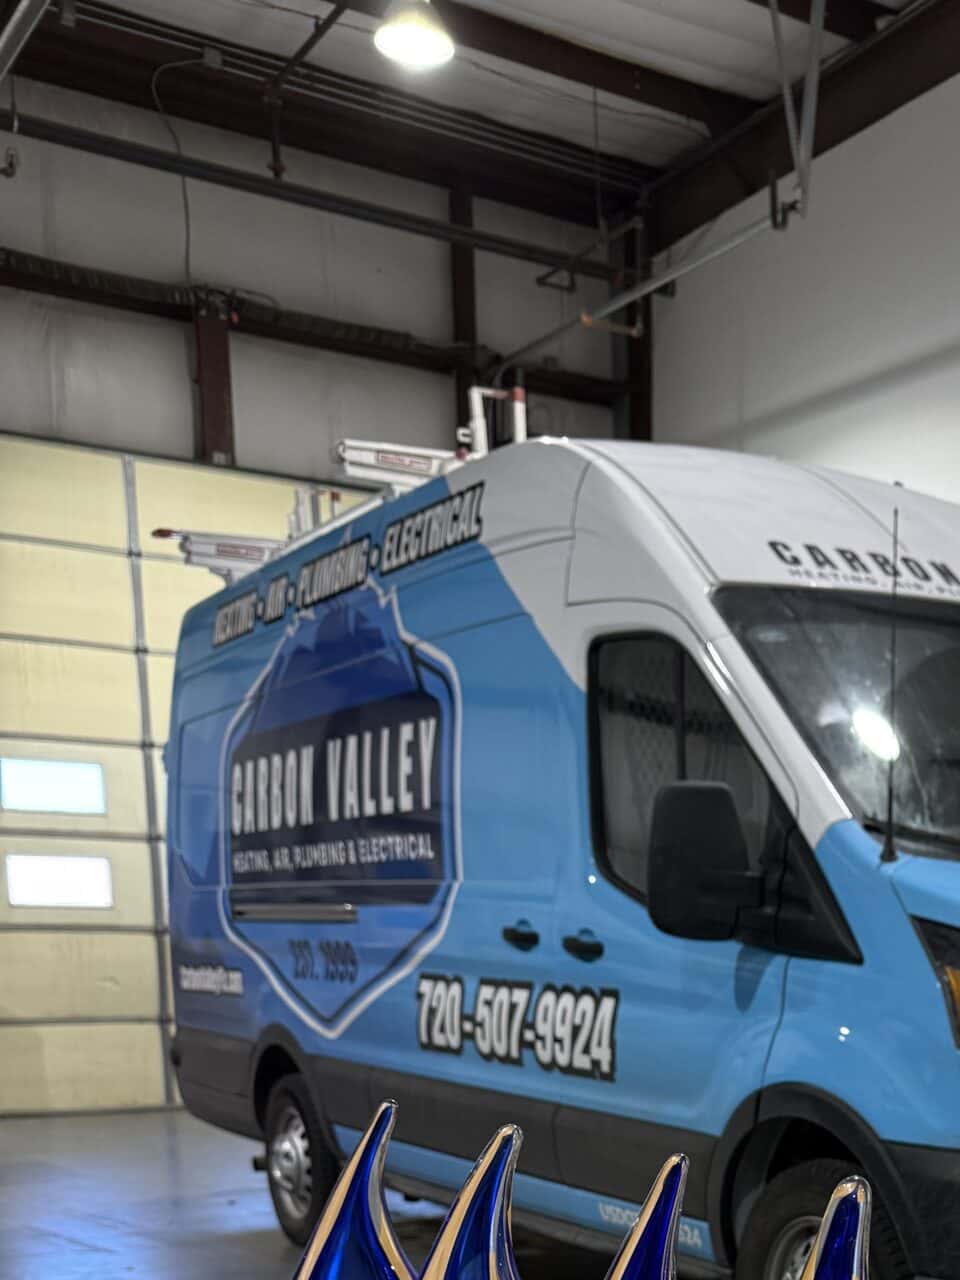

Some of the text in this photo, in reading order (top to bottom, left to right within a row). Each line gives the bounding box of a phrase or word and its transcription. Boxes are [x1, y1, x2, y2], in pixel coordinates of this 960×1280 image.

[381, 487, 483, 571] ELECTRICAL
[231, 717, 437, 836] CARBON VALLEY
[294, 841, 346, 869] PLUMBING
[359, 833, 435, 864] ELECTRICAL
[418, 977, 618, 1074] 720-507-9924
